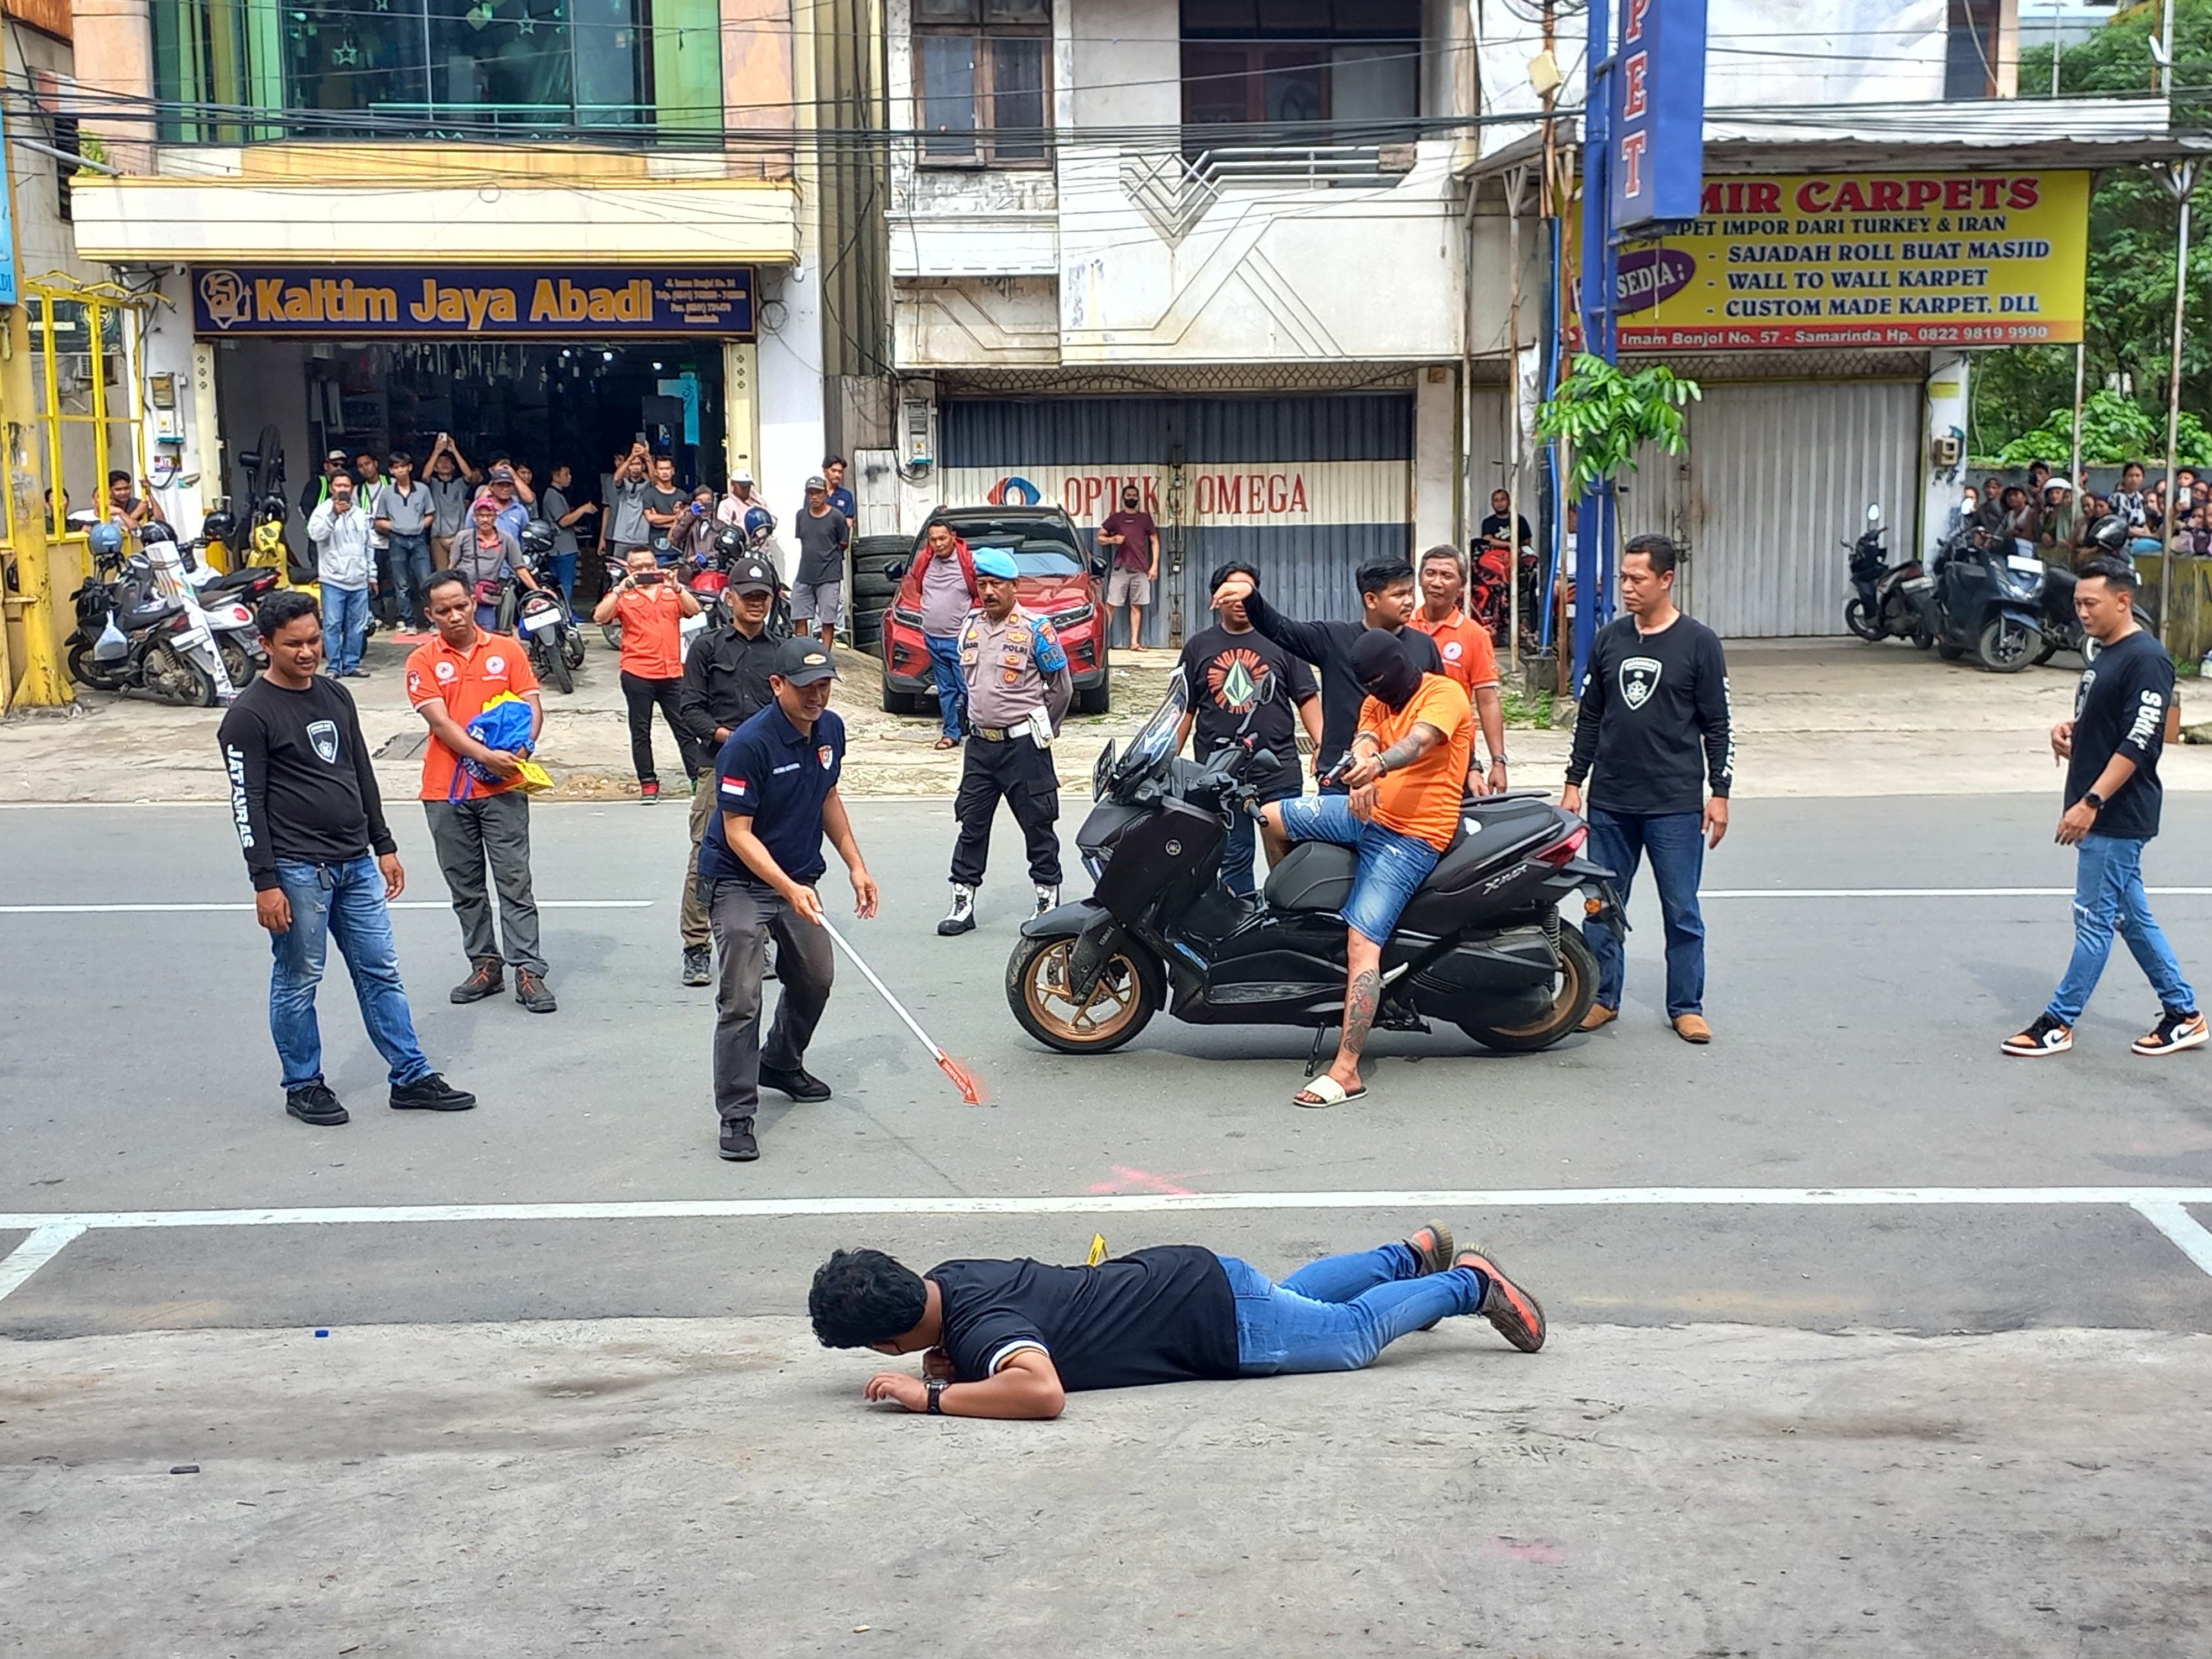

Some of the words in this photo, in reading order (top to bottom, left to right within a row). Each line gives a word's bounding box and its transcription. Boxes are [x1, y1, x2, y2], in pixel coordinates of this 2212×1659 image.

[1796, 177, 2040, 213] CARPETS
[1723, 220, 1789, 236] IMPOR
[1796, 219, 1844, 234] DARI
[1850, 216, 1931, 233] TURKEY
[1937, 217, 1951, 232] &
[1958, 216, 2006, 232] IRAN
[1728, 244, 1831, 263] SAJADAH
[1838, 243, 1895, 262] ROLL
[1901, 242, 1961, 260] BUAT
[1967, 241, 2051, 259] MASJID
[1727, 272, 1787, 290] WALL
[1794, 272, 1824, 289] TO
[1831, 271, 1891, 288] WALL
[1897, 269, 1988, 288] KARPET
[255, 278, 398, 321] Kaltim
[410, 278, 518, 331] Jaya
[529, 278, 653, 322] Abadi
[1725, 299, 1822, 317] CUSTOM
[1828, 298, 1891, 315] MADE
[1999, 295, 2039, 312] DLL
[1622, 333, 1665, 345] Imam
[1672, 332, 1723, 347] Bonjol
[1728, 332, 1755, 343] No.
[1761, 331, 1780, 342] 57
[1794, 330, 1881, 342] Samarinda
[1886, 329, 1912, 345] Hp.
[1918, 328, 1959, 341] 0822
[1195, 473, 1310, 515] OMEGA
[1003, 644, 1028, 654] POLRI
